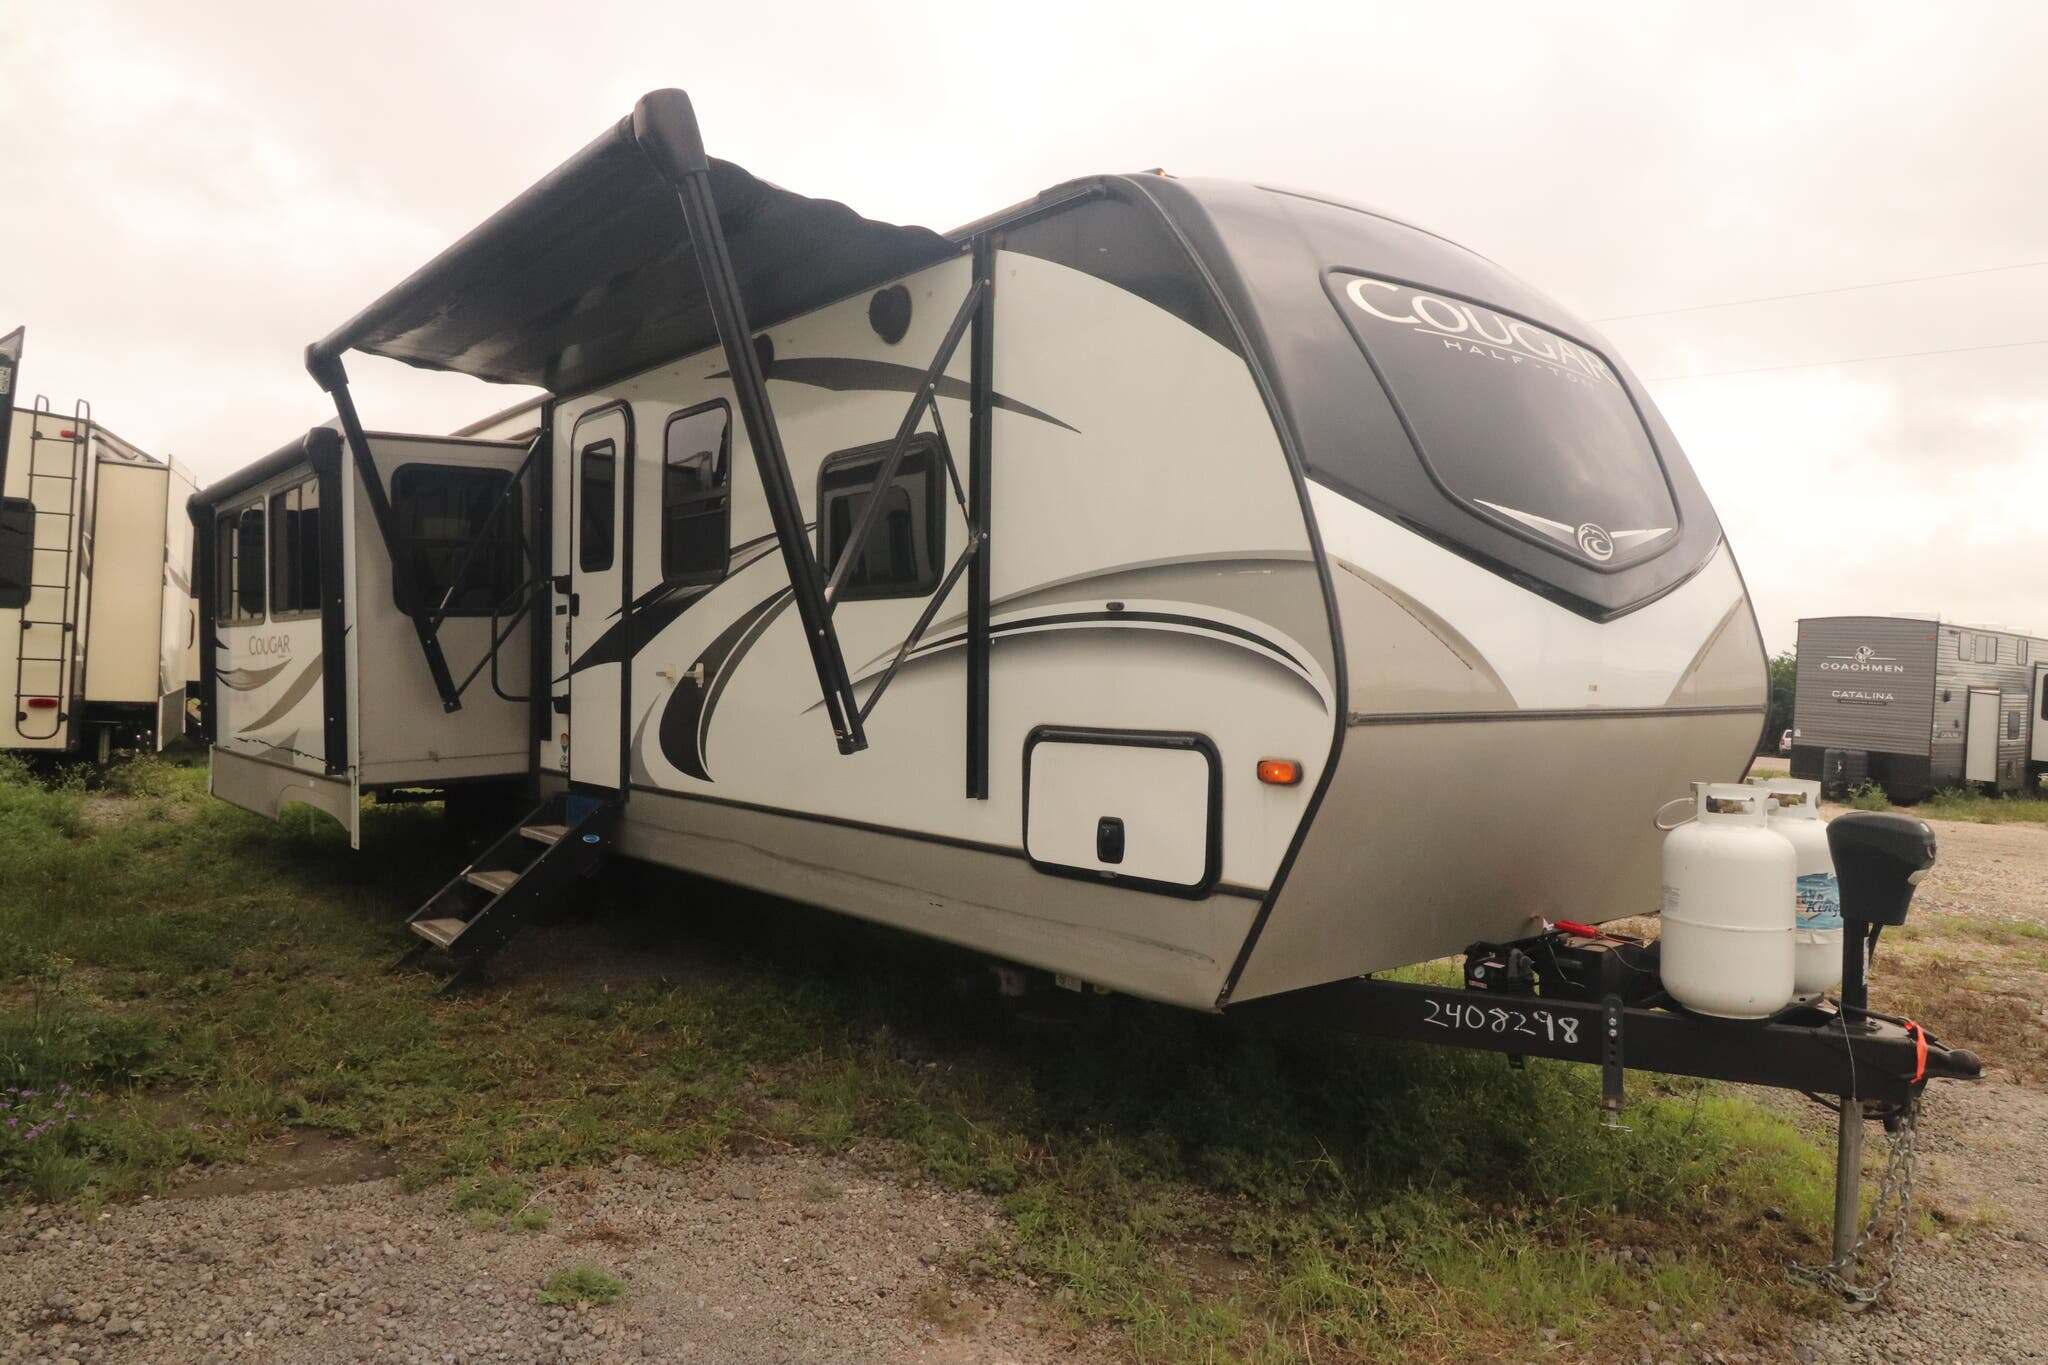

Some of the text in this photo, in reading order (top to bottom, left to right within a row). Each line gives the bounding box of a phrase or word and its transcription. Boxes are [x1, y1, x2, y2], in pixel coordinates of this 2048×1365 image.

[1346, 278, 1619, 389] COUGAR
[249, 635, 290, 656] COUGAR
[1820, 662, 1904, 673] COACHMEN
[1831, 690, 1894, 700] CATALINA
[1424, 1000, 1579, 1044] 2408298
